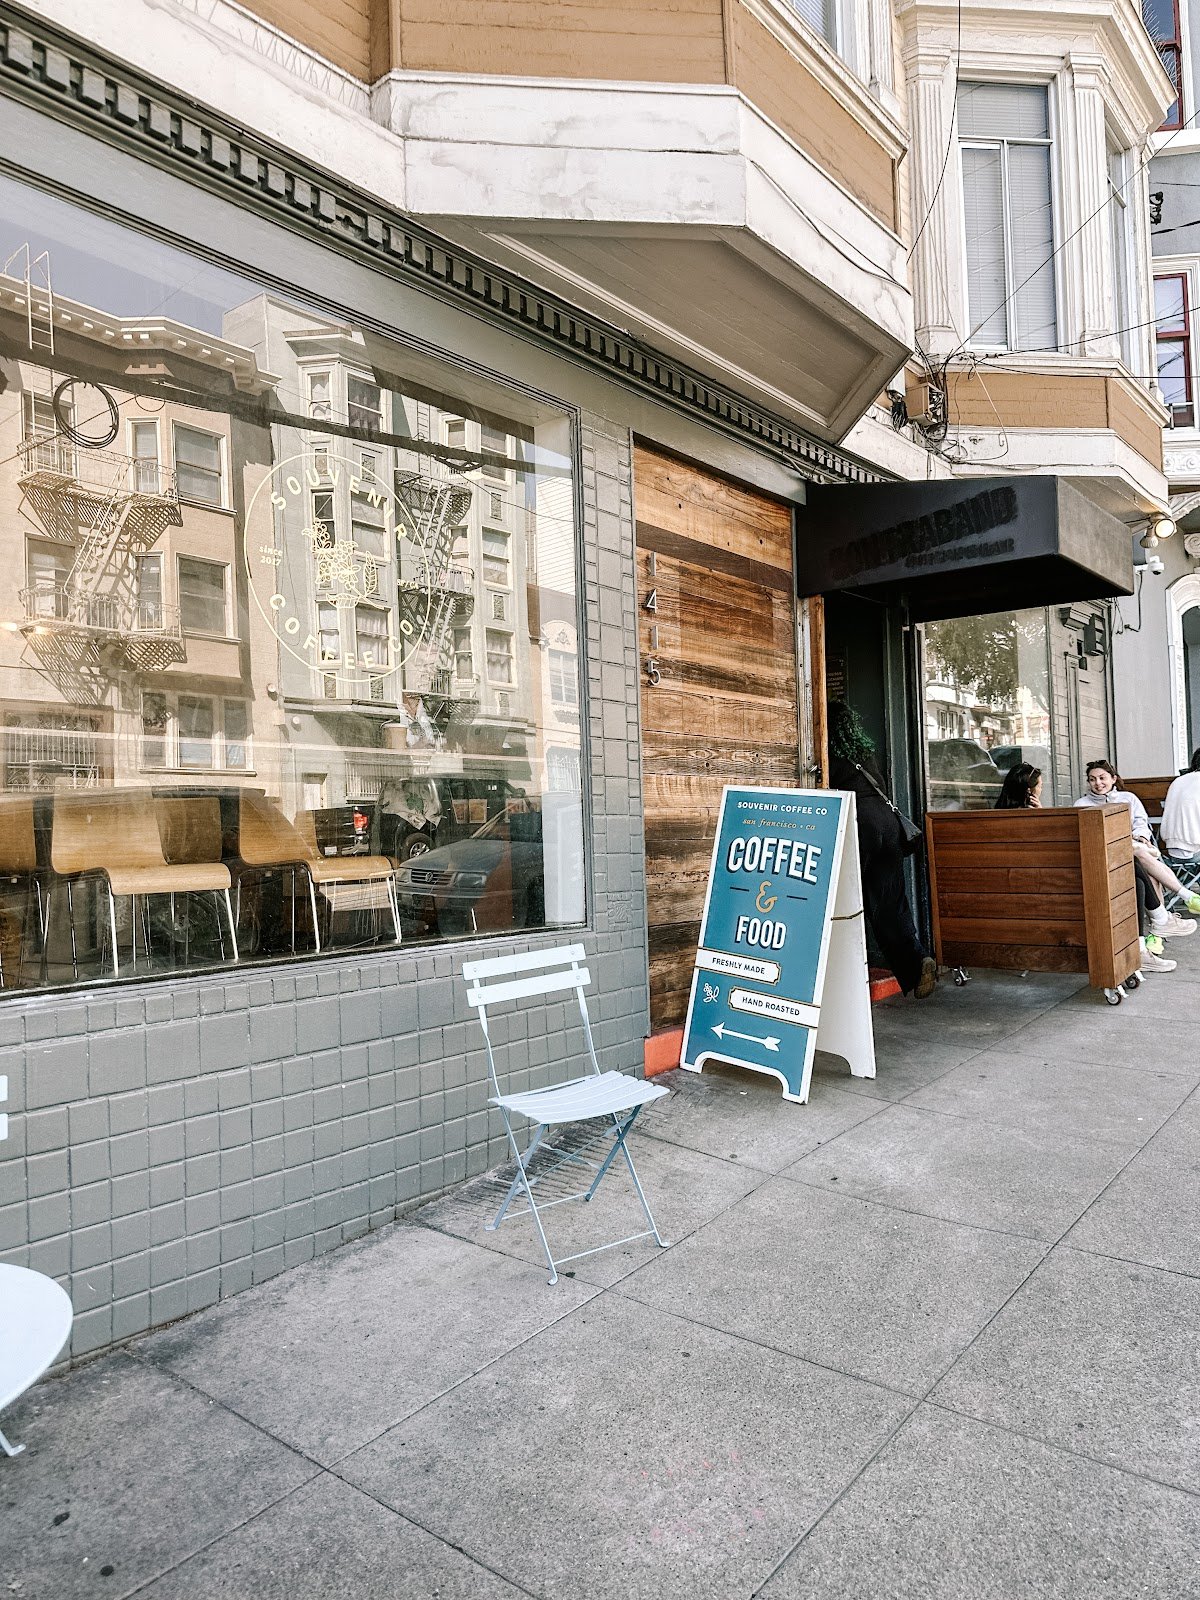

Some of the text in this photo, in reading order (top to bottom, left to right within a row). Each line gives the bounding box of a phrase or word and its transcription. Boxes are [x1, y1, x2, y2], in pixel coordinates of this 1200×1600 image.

[270, 468, 408, 541] SOUVENIR
[259, 545, 283, 556] since
[261, 556, 281, 566] 2017
[269, 594, 414, 670] COFFEE CO
[737, 801, 828, 815] SOUVENIR COFFEE CO
[758, 818, 797, 828] francisco
[727, 836, 822, 885] COFFEE
[756, 880, 778, 913] &
[735, 915, 787, 950] FOOD
[712, 957, 765, 974] FRESHLY MADE
[742, 996, 800, 1016] HAND ROASTED
